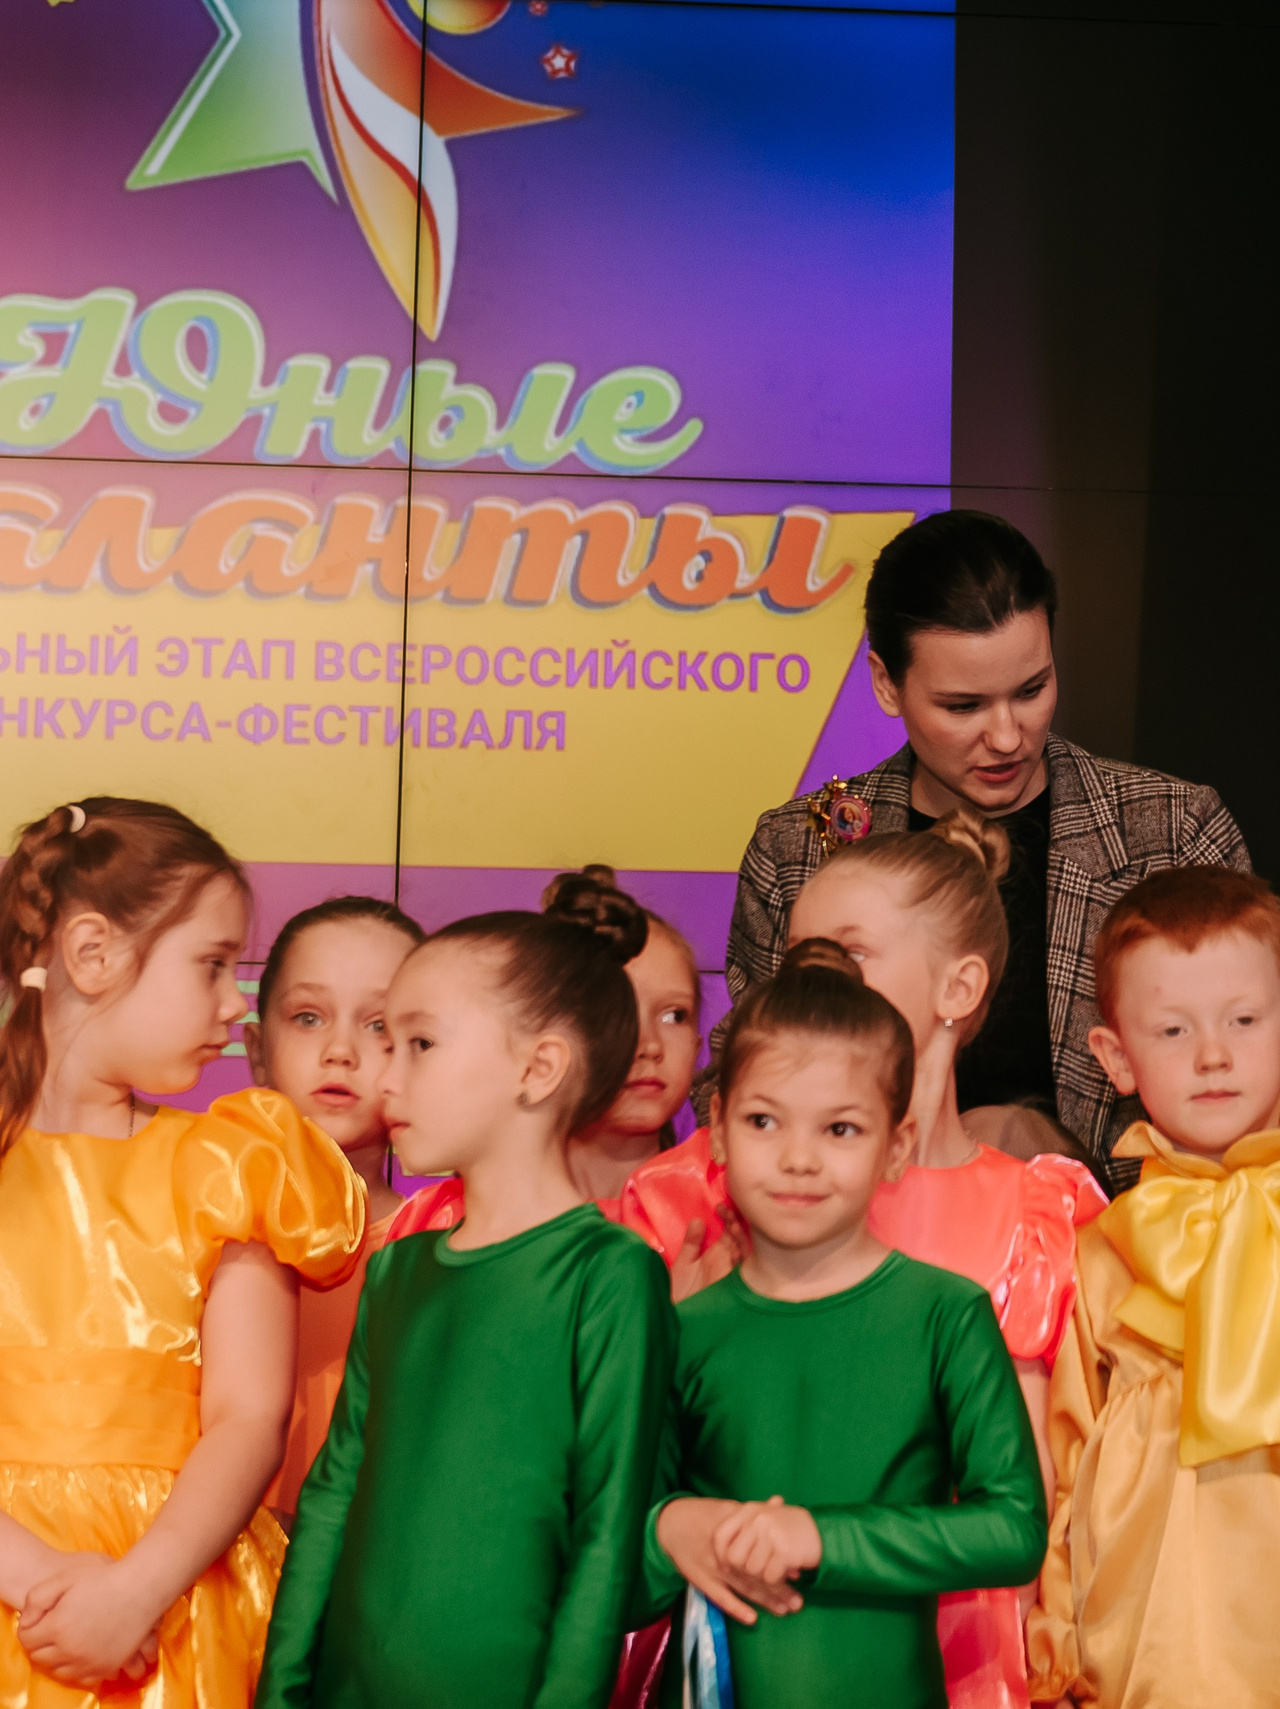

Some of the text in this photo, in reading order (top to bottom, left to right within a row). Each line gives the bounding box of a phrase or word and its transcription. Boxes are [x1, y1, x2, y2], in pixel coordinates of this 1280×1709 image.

[0, 287, 703, 475] Юные
[156, 636, 296, 680] ЭТАП
[314, 638, 811, 694] ВСЕРОССИЙСКОГО
